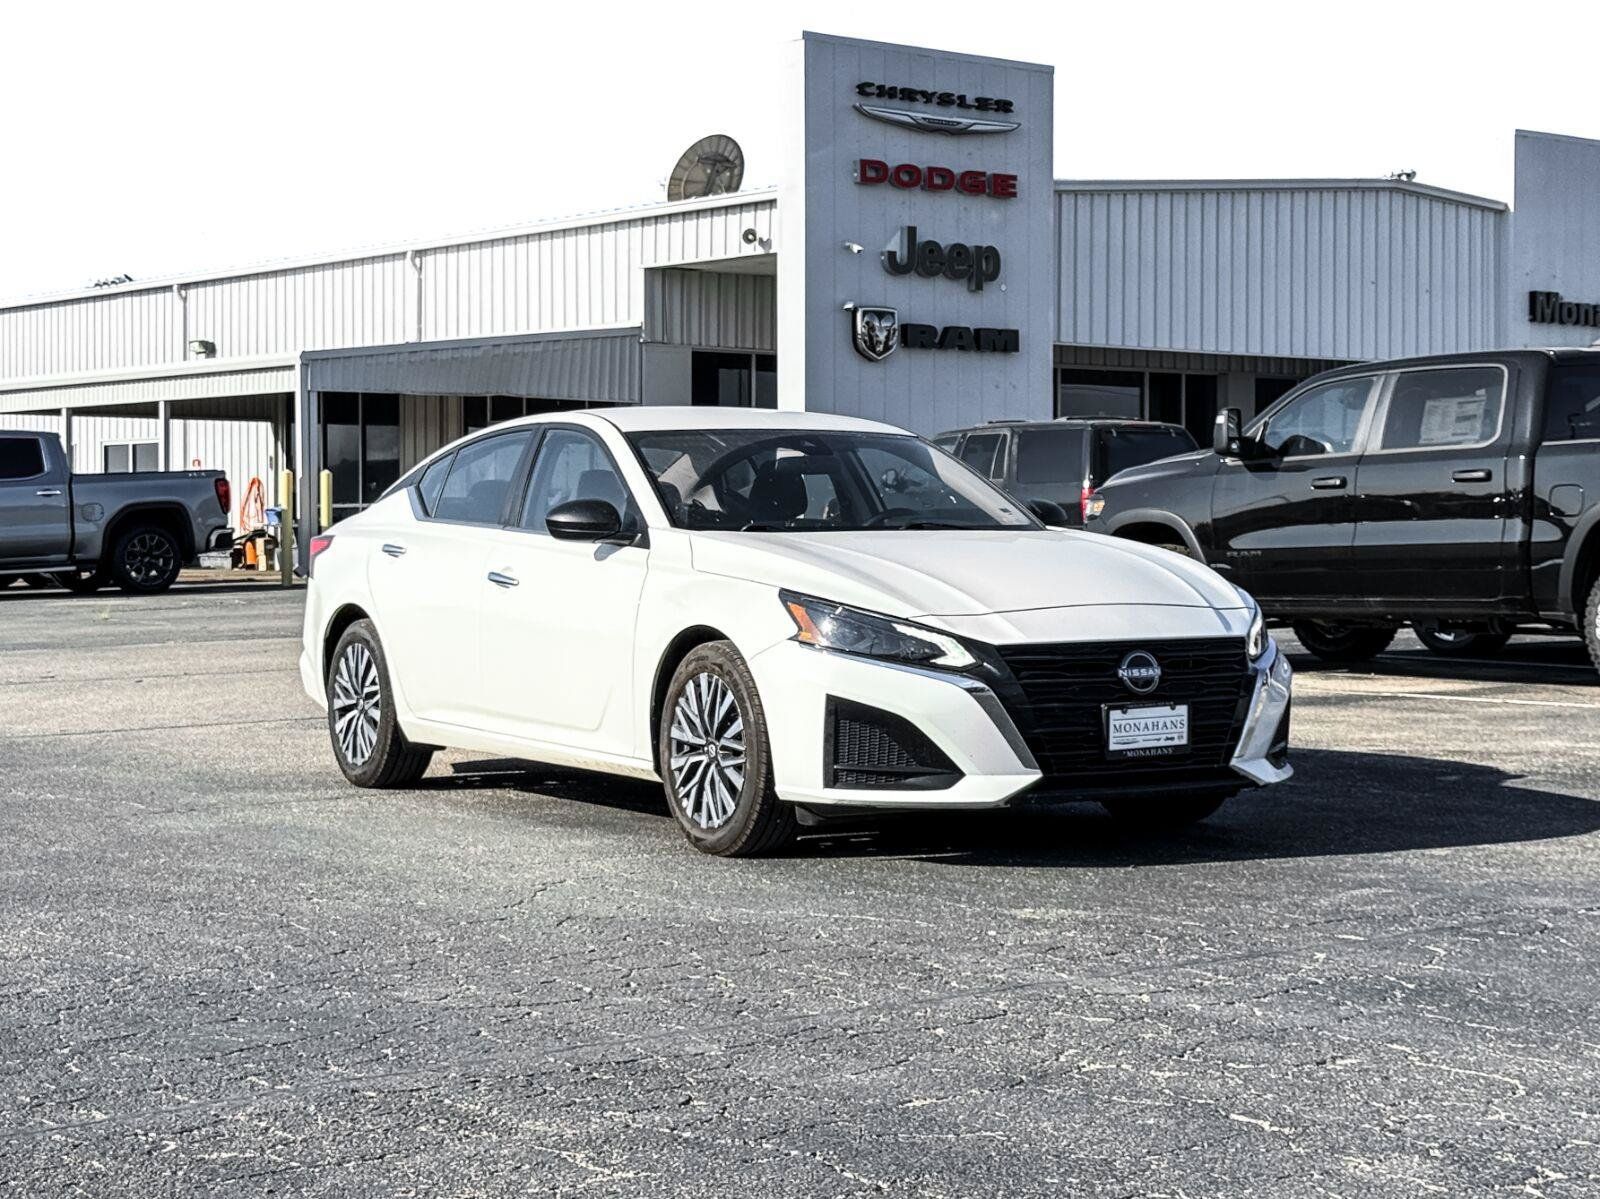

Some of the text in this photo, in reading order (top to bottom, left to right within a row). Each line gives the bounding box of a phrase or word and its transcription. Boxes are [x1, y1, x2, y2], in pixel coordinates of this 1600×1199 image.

[856, 81, 1014, 113] CHRYSLER
[855, 158, 1018, 199] DODGE
[882, 225, 1001, 292] Jeep
[902, 323, 1020, 353] RAM
[1112, 719, 1185, 734] MONAHANS
